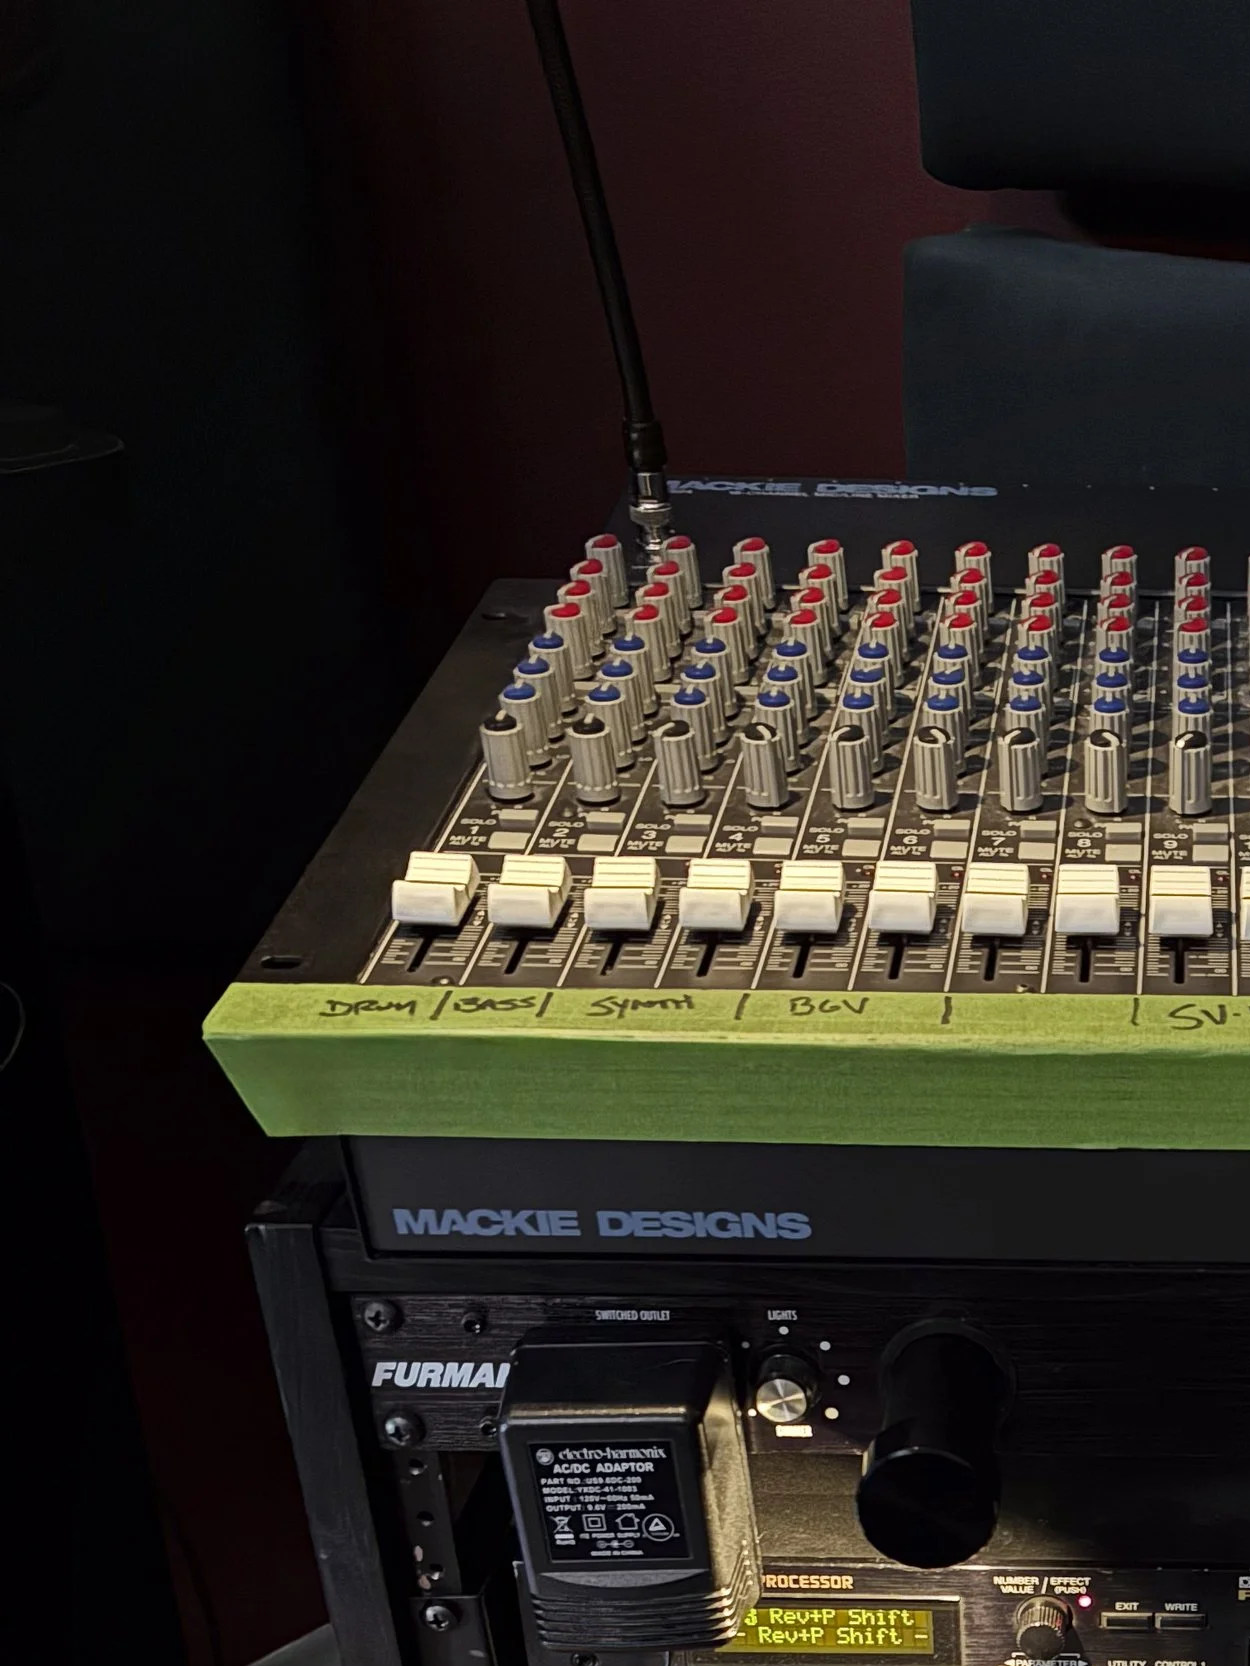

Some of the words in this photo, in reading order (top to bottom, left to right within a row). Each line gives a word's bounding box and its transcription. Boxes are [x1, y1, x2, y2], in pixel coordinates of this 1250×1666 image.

[815, 482, 998, 496] DESIGNS
[553, 828, 570, 837] 2
[641, 830, 656, 839] 3
[729, 832, 743, 841] 4
[816, 834, 830, 843] 5
[903, 835, 918, 844] 6
[992, 837, 1004, 846] 7
[1077, 838, 1091, 847] 8
[1163, 840, 1178, 849] 9
[393, 1209, 581, 1237] MACKIE
[596, 1211, 812, 1240] DESIGNS
[596, 1309, 638, 1321] SWITCHED
[640, 1309, 670, 1321] OUTLET
[768, 1309, 798, 1321] LIGHTS
[559, 1446, 666, 1460] electro-harmonix
[553, 1463, 590, 1474] AC/DC
[596, 1462, 654, 1472] ADAPTOR
[994, 1576, 1039, 1585] NUMBER
[1050, 1577, 1091, 1586] EFFECT
[1000, 1585, 1034, 1594] VALUE
[1054, 1585, 1086, 1594] (PUSH)
[1115, 1602, 1139, 1611] EXIT
[1165, 1603, 1198, 1611] WRITE
[769, 1608, 835, 1626] Rev+P
[848, 1609, 914, 1626] Shift
[758, 1627, 824, 1644] Rev+P
[837, 1628, 902, 1645] Shift
